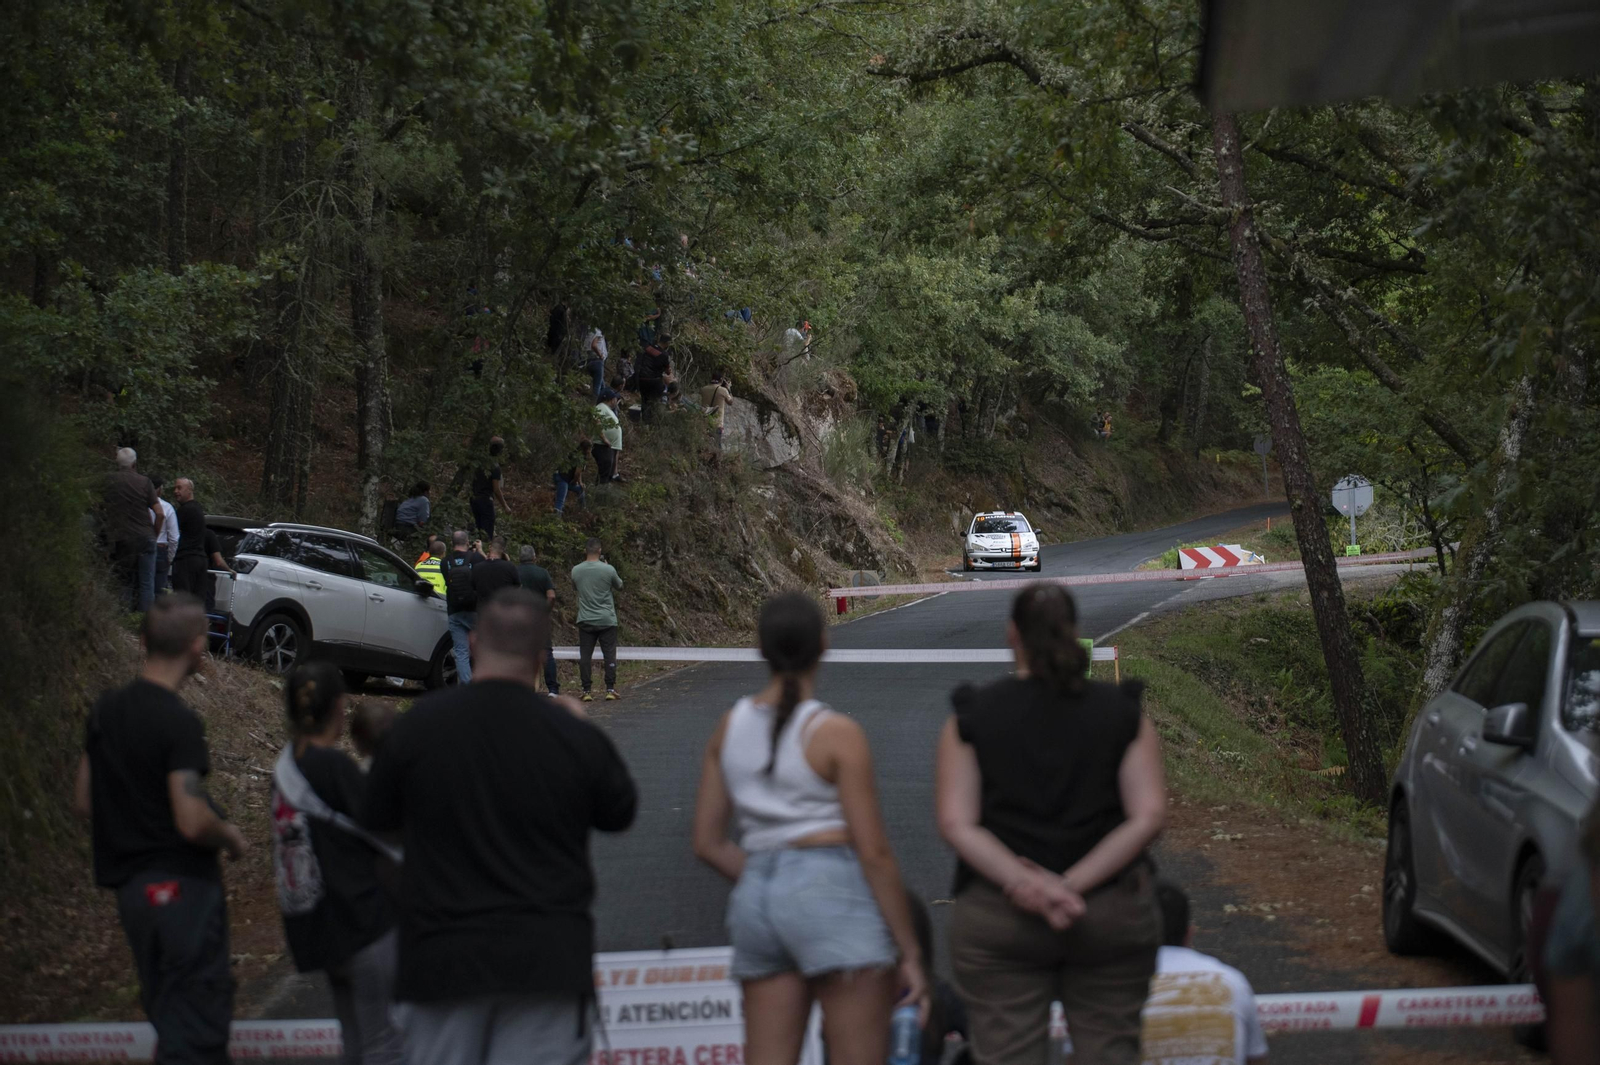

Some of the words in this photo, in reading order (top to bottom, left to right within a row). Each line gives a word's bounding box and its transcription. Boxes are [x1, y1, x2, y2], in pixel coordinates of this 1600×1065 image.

[617, 996, 731, 1022] ATENCIÓN
[1397, 996, 1497, 1010] CARRETERA
[57, 1030, 136, 1045] CORTADA
